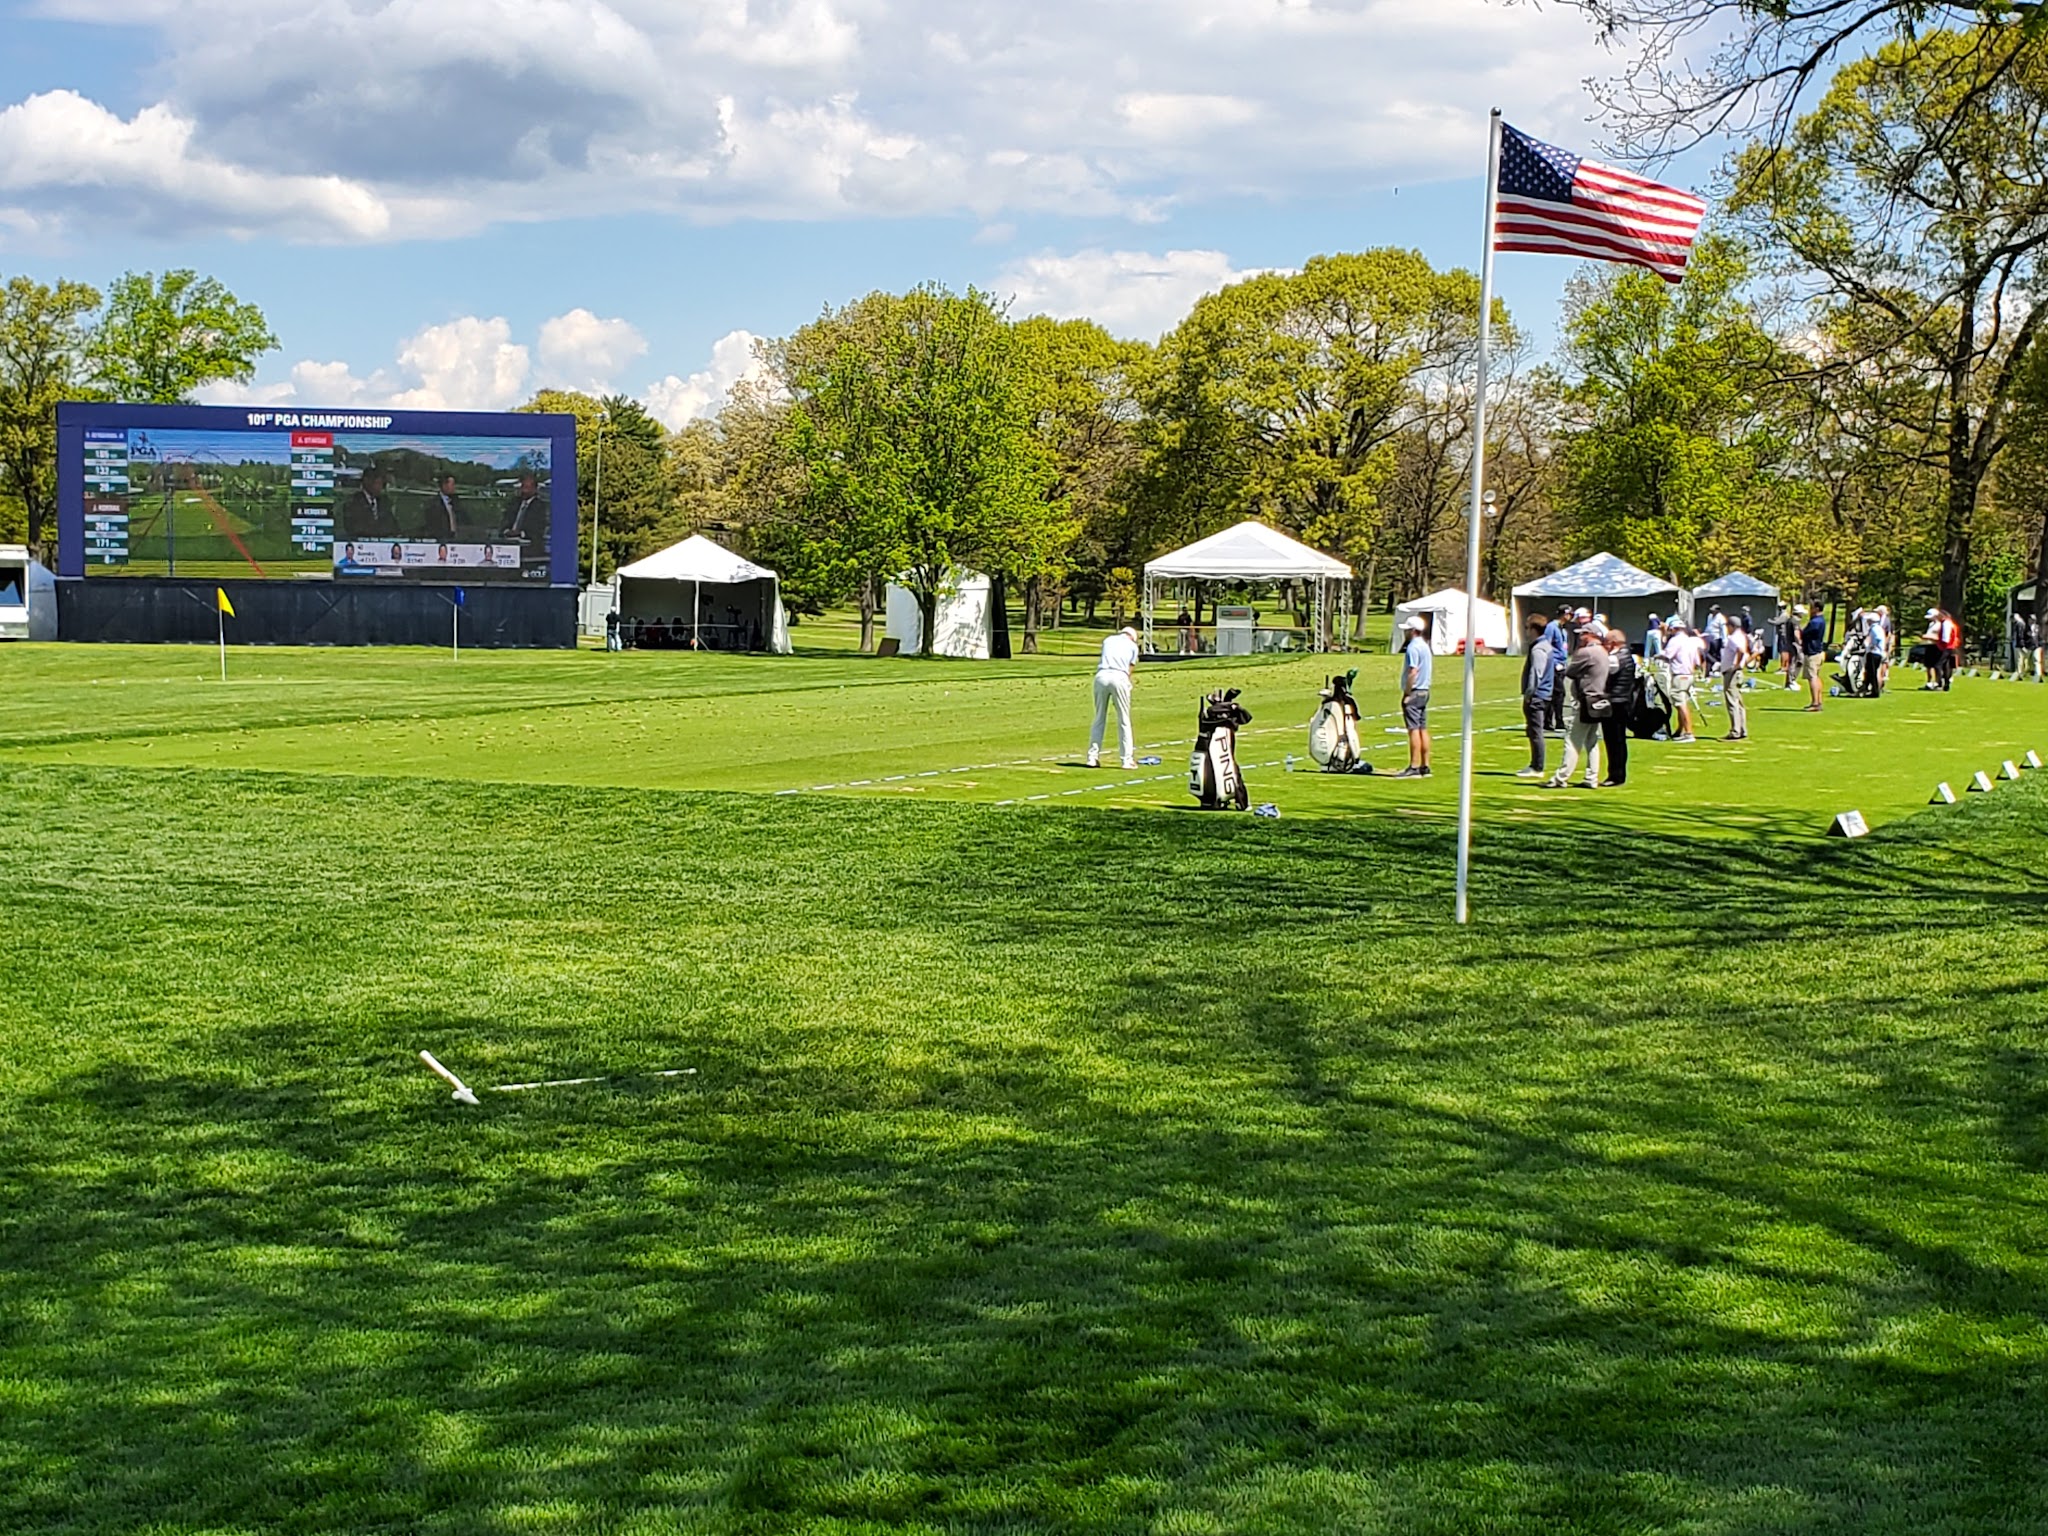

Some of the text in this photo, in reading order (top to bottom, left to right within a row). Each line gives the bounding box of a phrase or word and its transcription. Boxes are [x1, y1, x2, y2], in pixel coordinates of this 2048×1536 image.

[274, 414, 300, 427] PGA
[301, 414, 393, 429] CHAMPIONSHIP
[1215, 735, 1236, 795] PING
